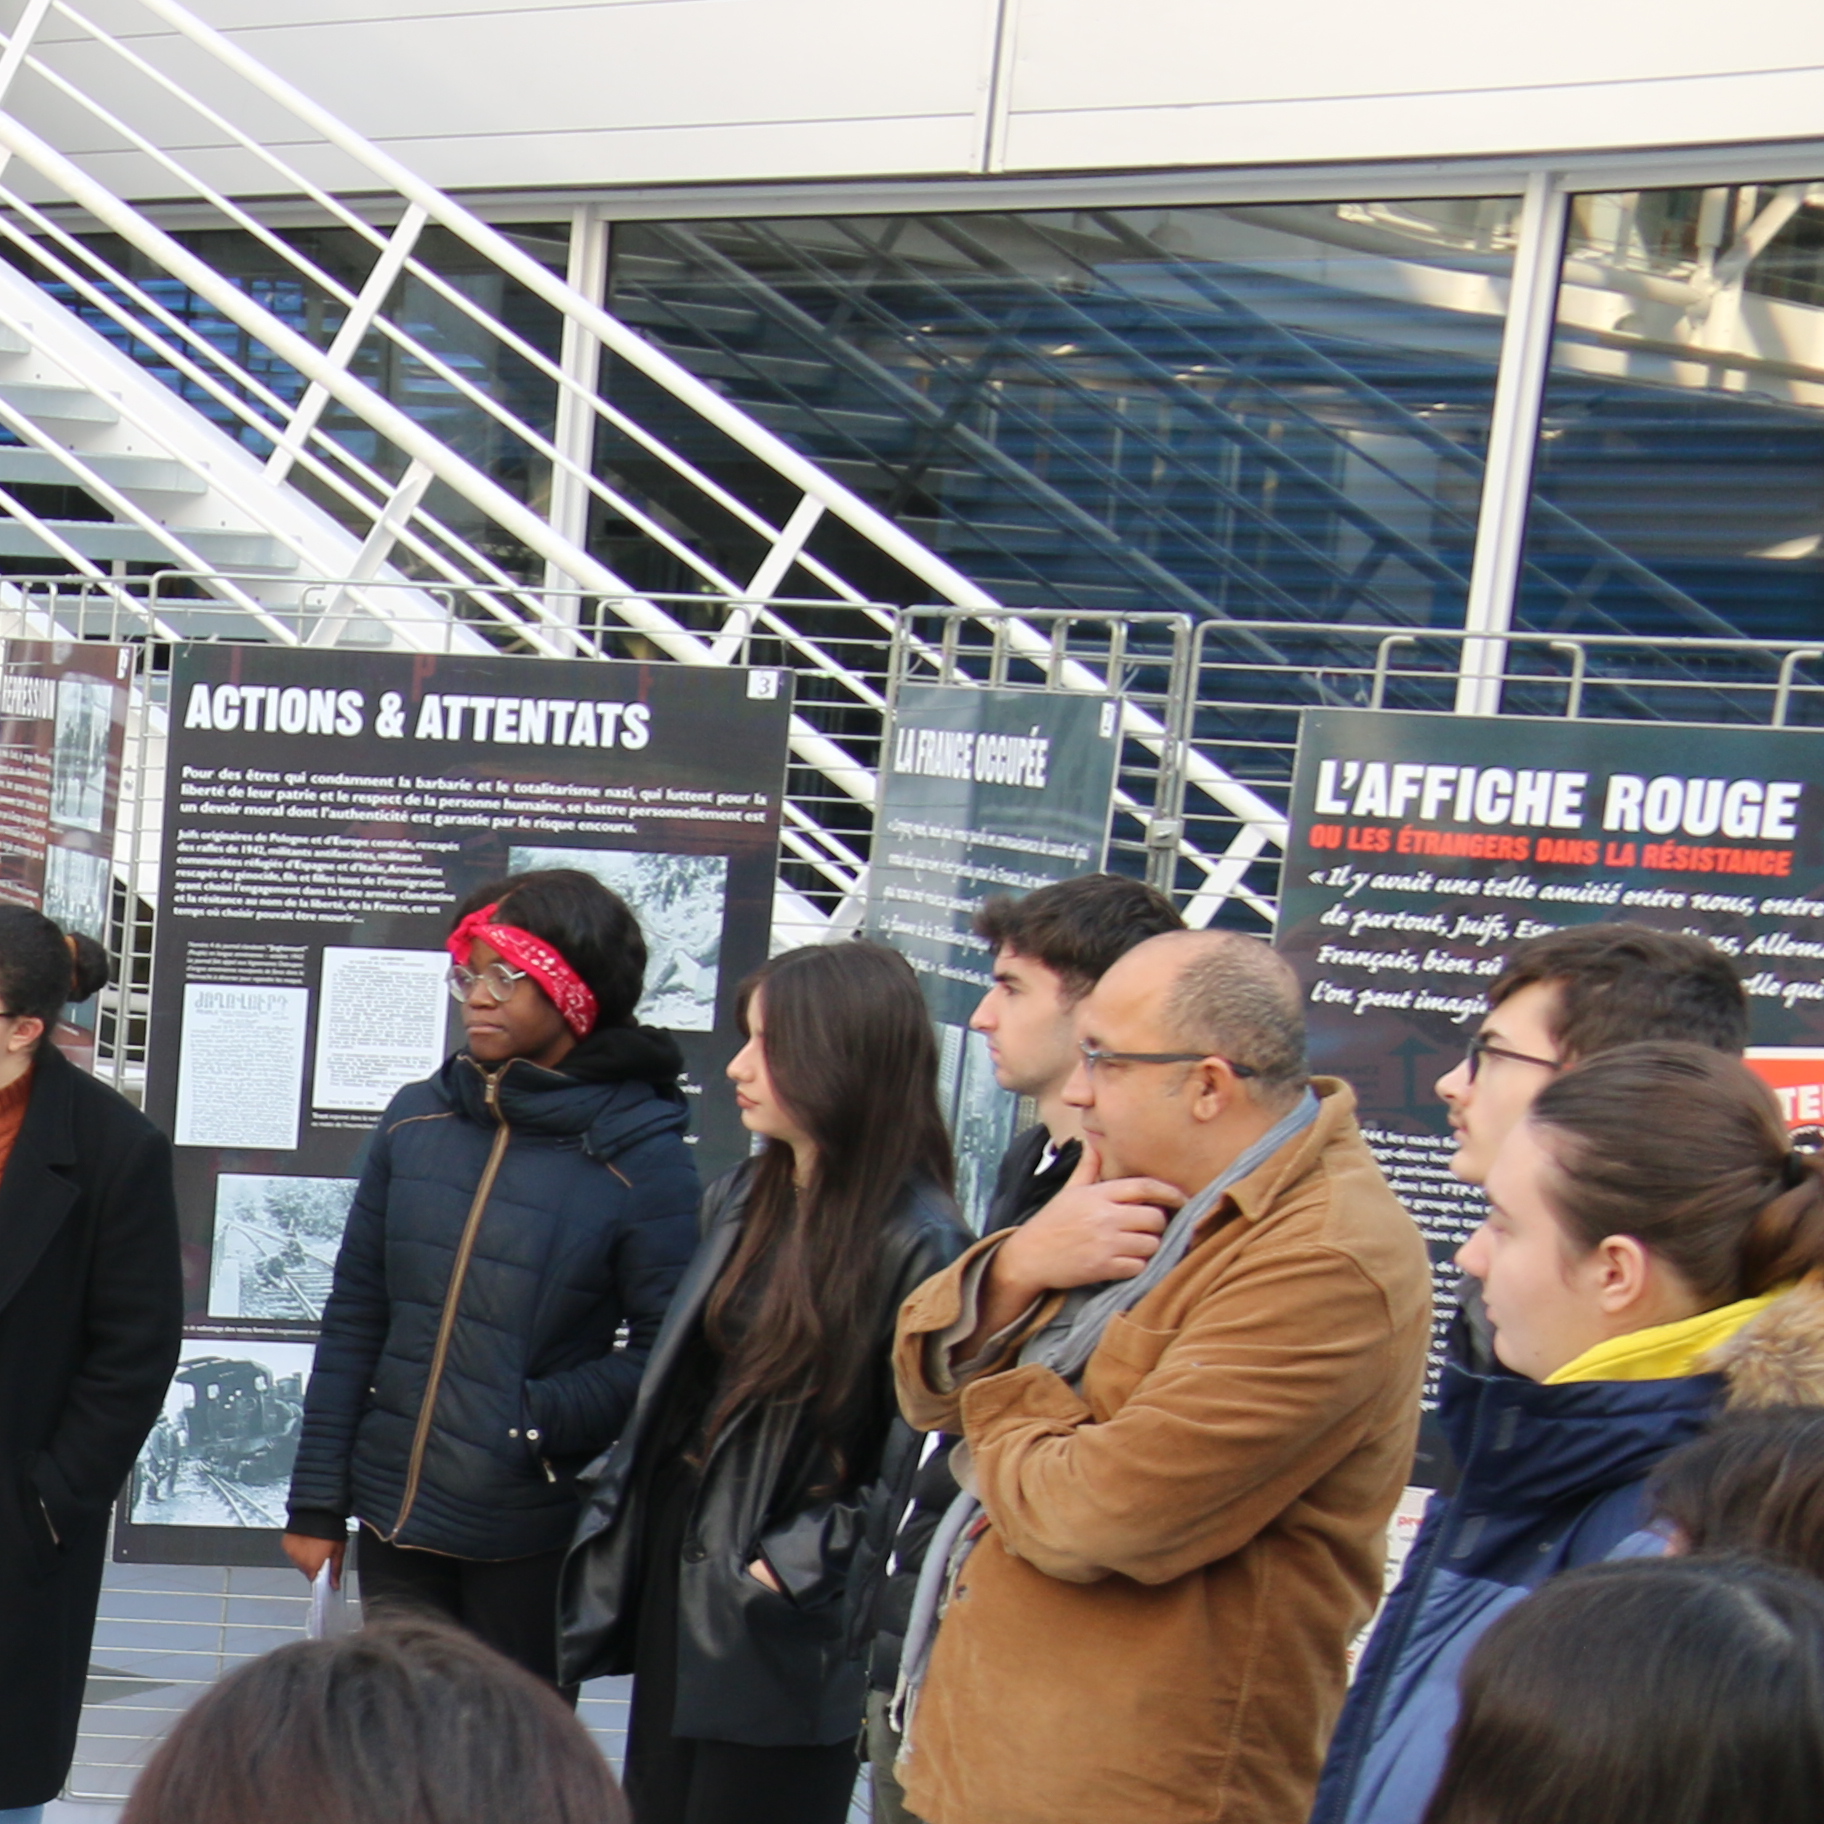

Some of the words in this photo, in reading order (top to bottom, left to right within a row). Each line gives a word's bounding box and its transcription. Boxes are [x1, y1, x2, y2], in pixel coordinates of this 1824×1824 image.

[758, 674, 771, 695] 3
[185, 683, 364, 738] ACTIONS
[374, 692, 406, 738] &
[416, 693, 651, 750] ATTENTATS
[894, 727, 914, 774] LA
[916, 730, 974, 780] FRANCE
[974, 724, 1049, 788] OCCUPÉE
[182, 766, 214, 779] Pour
[218, 768, 241, 781] des
[246, 769, 280, 782] êtres
[284, 772, 306, 787] qui
[310, 773, 394, 788] condamnent
[398, 776, 411, 788] la
[415, 777, 472, 791] barbarie
[477, 780, 492, 792] et
[496, 781, 509, 793] le
[514, 782, 600, 797] totalitarisme
[605, 787, 637, 801] nazi,
[640, 788, 662, 803] qui
[666, 789, 713, 802] luttent
[717, 795, 750, 807] pour
[754, 793, 767, 805] la
[1314, 758, 1588, 830] L'AFFICHE
[1602, 774, 1802, 841] ROUGE
[1309, 824, 1339, 850] OU
[1346, 826, 1392, 852] LES
[1397, 824, 1531, 861] ÉTRANGERS
[1535, 839, 1599, 866] DANS
[1606, 840, 1635, 868] LA
[1641, 839, 1793, 877] RÉSISTANCE
[1325, 866, 1348, 887] Il
[1348, 873, 1369, 897] y
[1370, 868, 1430, 892] avait
[1434, 877, 1480, 896] une
[1483, 874, 1535, 901] telle
[1538, 880, 1622, 905] amitié
[1621, 887, 1684, 910] entre
[1692, 893, 1756, 917] nous,
[1760, 895, 1824, 919] entre
[1320, 904, 1350, 928] de
[1351, 907, 1450, 937] partout,
[1452, 912, 1511, 946] Juifs,
[1316, 945, 1420, 973] Français,
[1422, 955, 1471, 975] bien
[1311, 981, 1354, 1007] l'on
[1354, 987, 1413, 1015] peut
